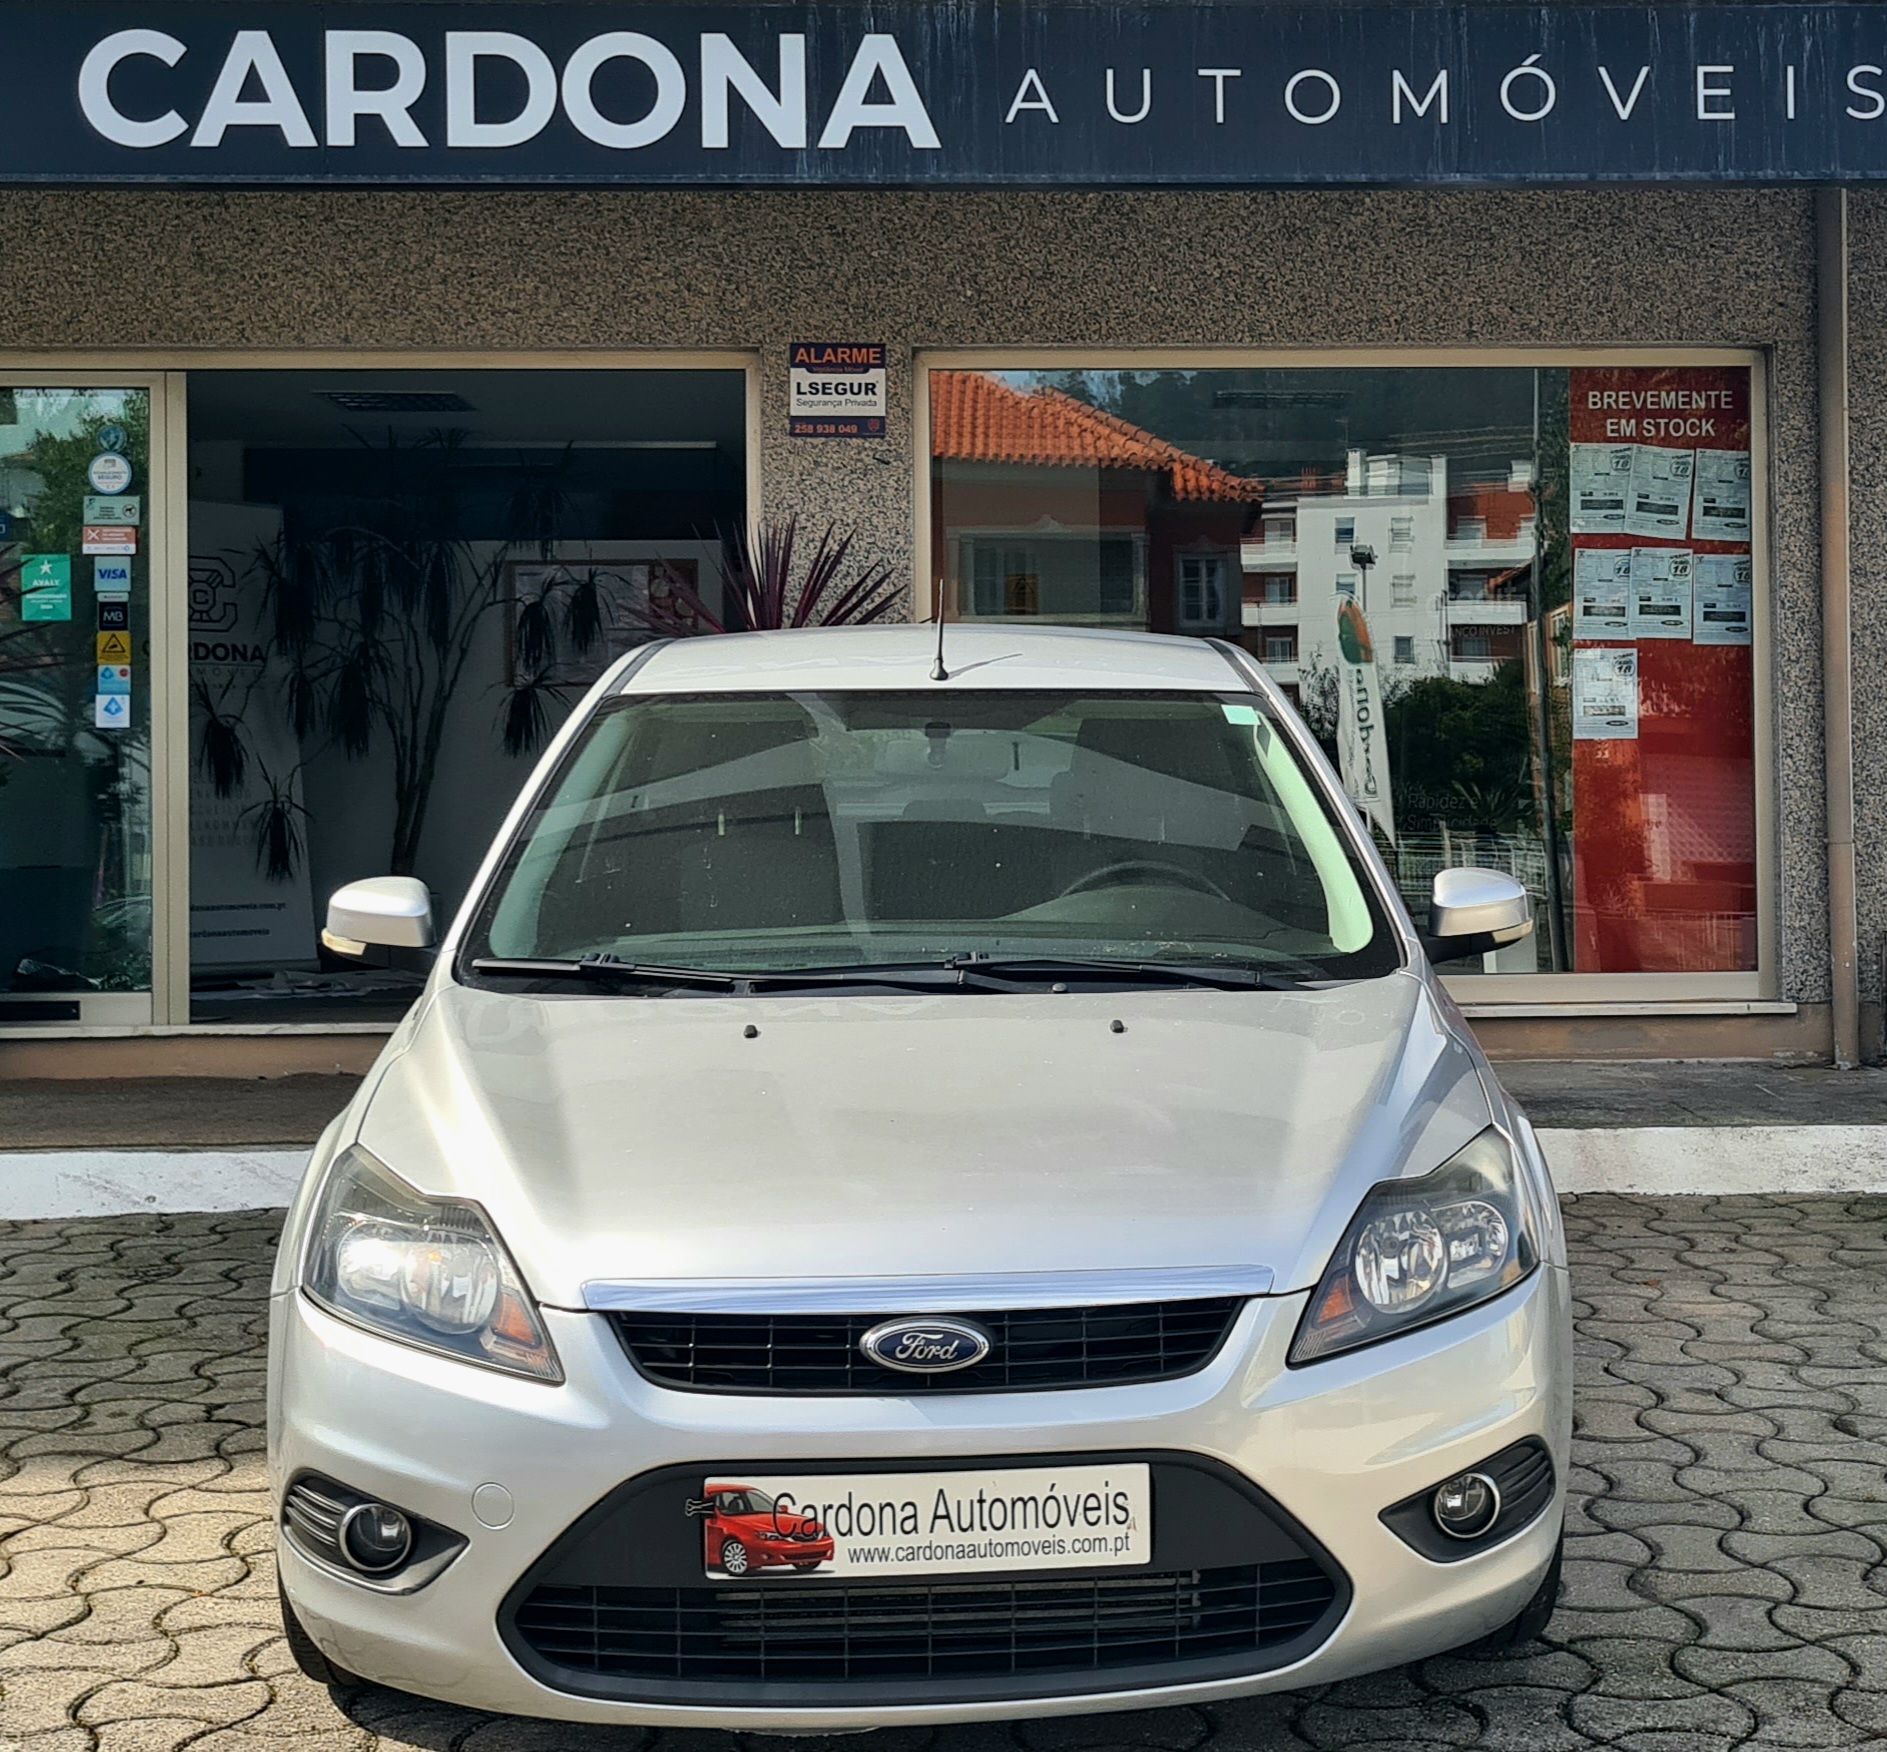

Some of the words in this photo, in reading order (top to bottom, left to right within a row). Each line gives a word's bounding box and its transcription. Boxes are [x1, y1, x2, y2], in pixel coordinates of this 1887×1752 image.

[78, 28, 942, 149] CARDONA
[1005, 53, 1887, 124] AUTOMÓVEIS
[794, 347, 882, 364] ALARME
[796, 381, 877, 396] LSEGUR
[796, 398, 842, 408] Segurança
[845, 398, 877, 407] Privada
[1587, 390, 1733, 410] BREVEMENTE
[794, 424, 814, 434] 258
[816, 424, 836, 434] 938
[838, 424, 858, 434] 049
[1606, 418, 1636, 437] EM
[1642, 418, 1716, 438] STOCK
[97, 568, 127, 580] VISA
[102, 607, 124, 622] MB
[895, 1332, 960, 1360] Ford
[772, 1491, 919, 1539] Cardona
[929, 1480, 1131, 1535] Automóveis
[847, 1532, 1131, 1565] www.cardonaautomoveis.com.pt
